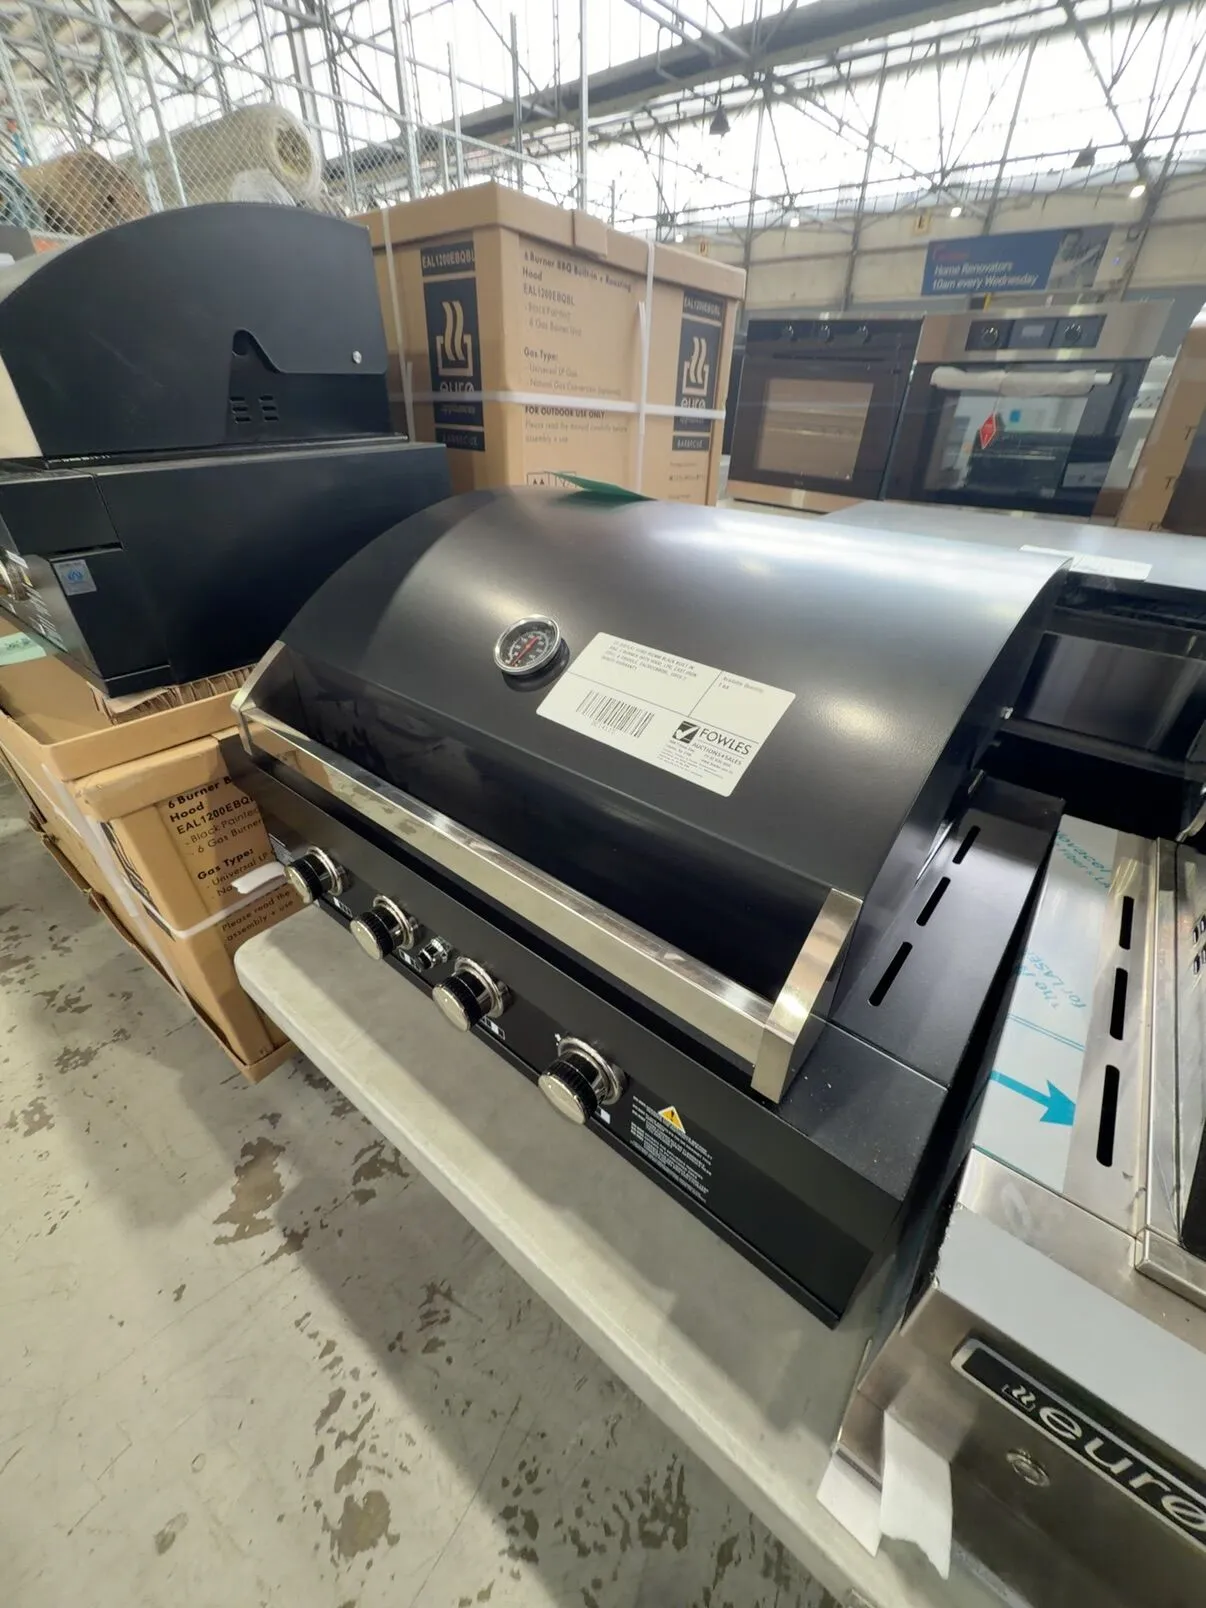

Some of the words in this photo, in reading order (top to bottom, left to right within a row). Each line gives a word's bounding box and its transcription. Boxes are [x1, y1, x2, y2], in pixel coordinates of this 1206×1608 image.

[522, 266, 543, 282] Hood
[529, 251, 556, 268] Burner
[557, 259, 572, 274] BBQ
[934, 264, 960, 275] Home
[961, 261, 1013, 275] Renovators
[933, 278, 956, 291] 10am
[984, 273, 1039, 289] Wednesday
[524, 347, 538, 359] Gas
[525, 405, 540, 416] FOR
[541, 405, 574, 418] OUTDOOR
[575, 408, 587, 419] USE
[588, 409, 606, 420] ONLY
[699, 728, 752, 755] FOWLES
[168, 800, 175, 809] 6
[177, 782, 220, 805] Burner
[169, 801, 205, 823] Hood
[190, 824, 219, 844] Black
[197, 844, 205, 854] 6
[207, 834, 229, 848] Gas
[231, 819, 262, 837] Burner
[197, 864, 221, 881] Gas
[223, 848, 254, 867] Type:
[211, 859, 257, 887] Universal
[217, 885, 233, 897] Na
[221, 911, 252, 932] Please
[254, 898, 275, 913] read
[276, 890, 290, 900] the
[226, 913, 268, 942] assembly
[279, 901, 294, 912] use
[1038, 1406, 1206, 1532] euro
